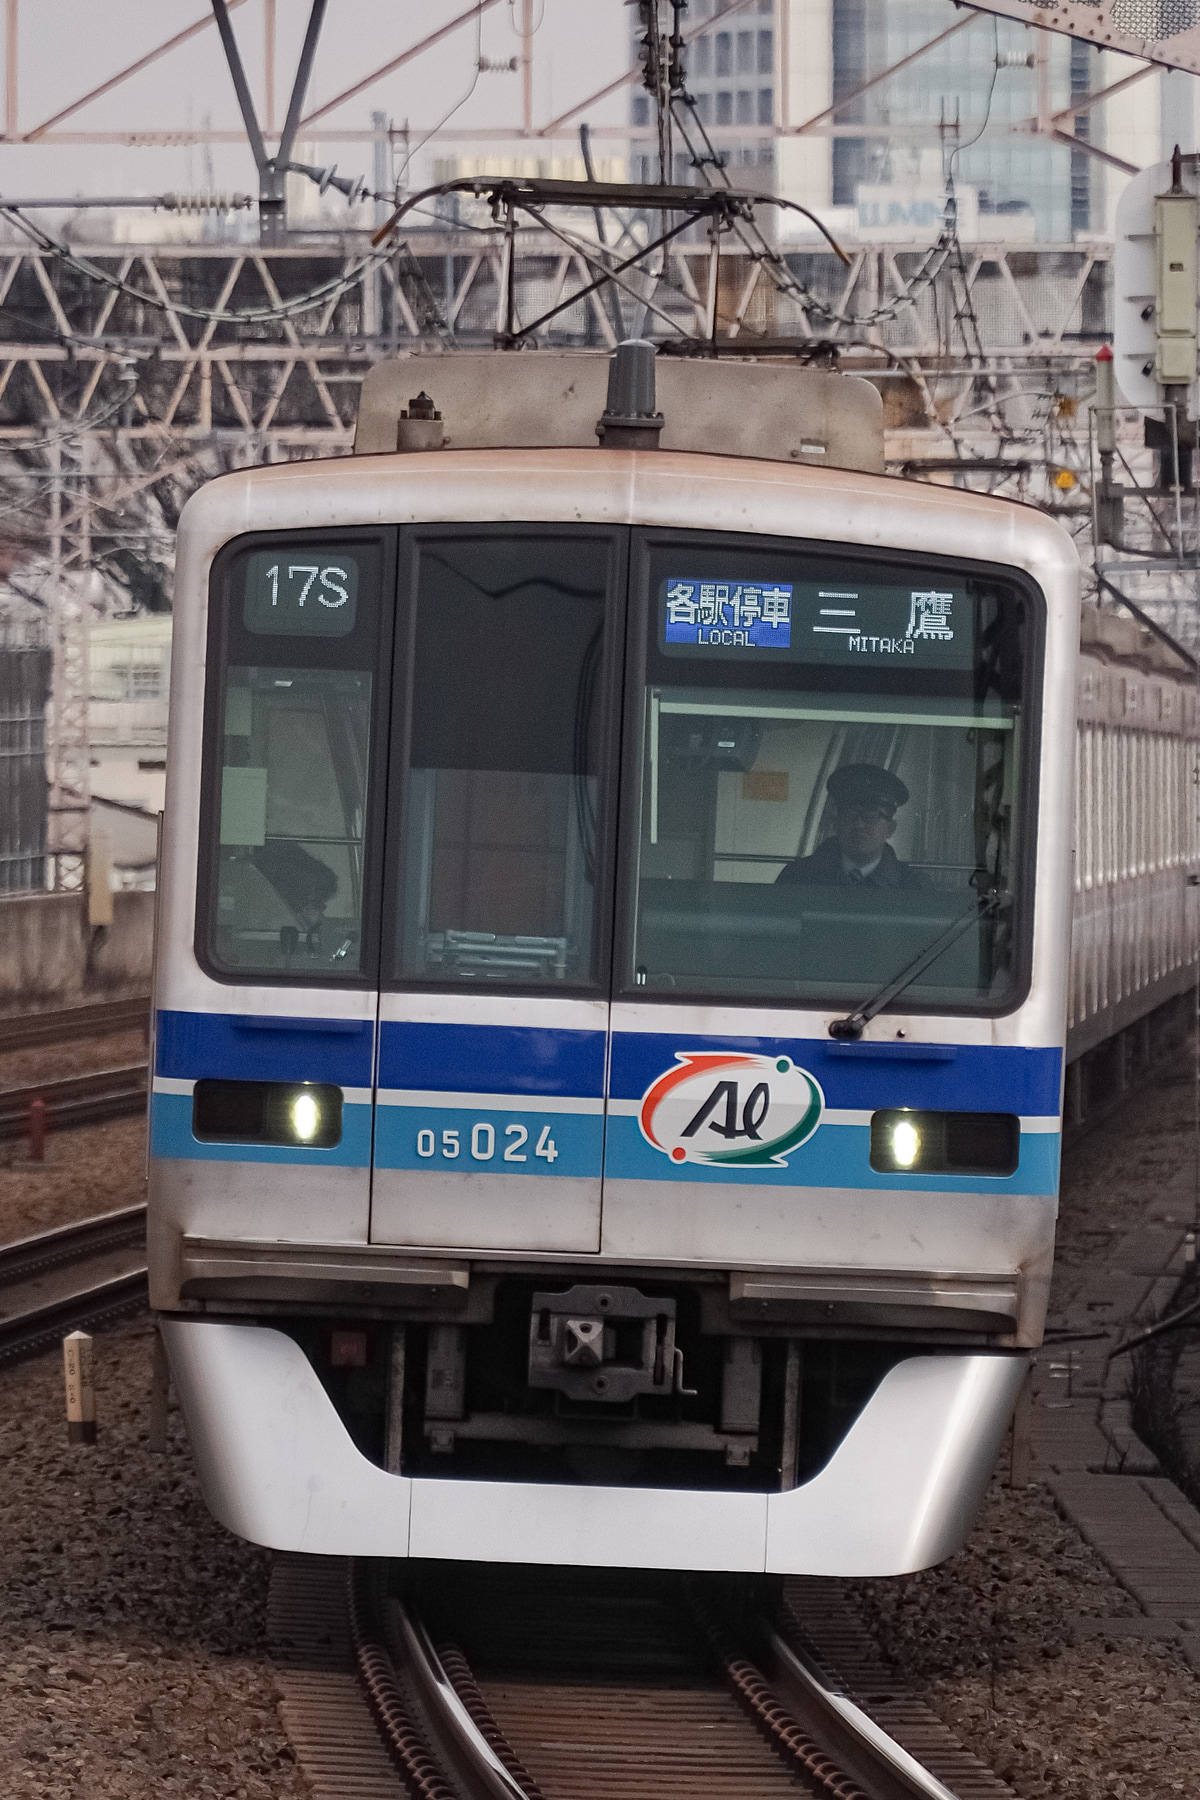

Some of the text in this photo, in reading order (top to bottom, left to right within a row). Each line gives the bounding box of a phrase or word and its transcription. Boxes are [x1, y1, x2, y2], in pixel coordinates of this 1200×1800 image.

[265, 565, 349, 608] 17S
[666, 583, 791, 629] 各駅停車
[697, 628, 756, 647] LOCAL
[849, 635, 915, 654] MITAKA
[416, 1122, 559, 1164] 05024
